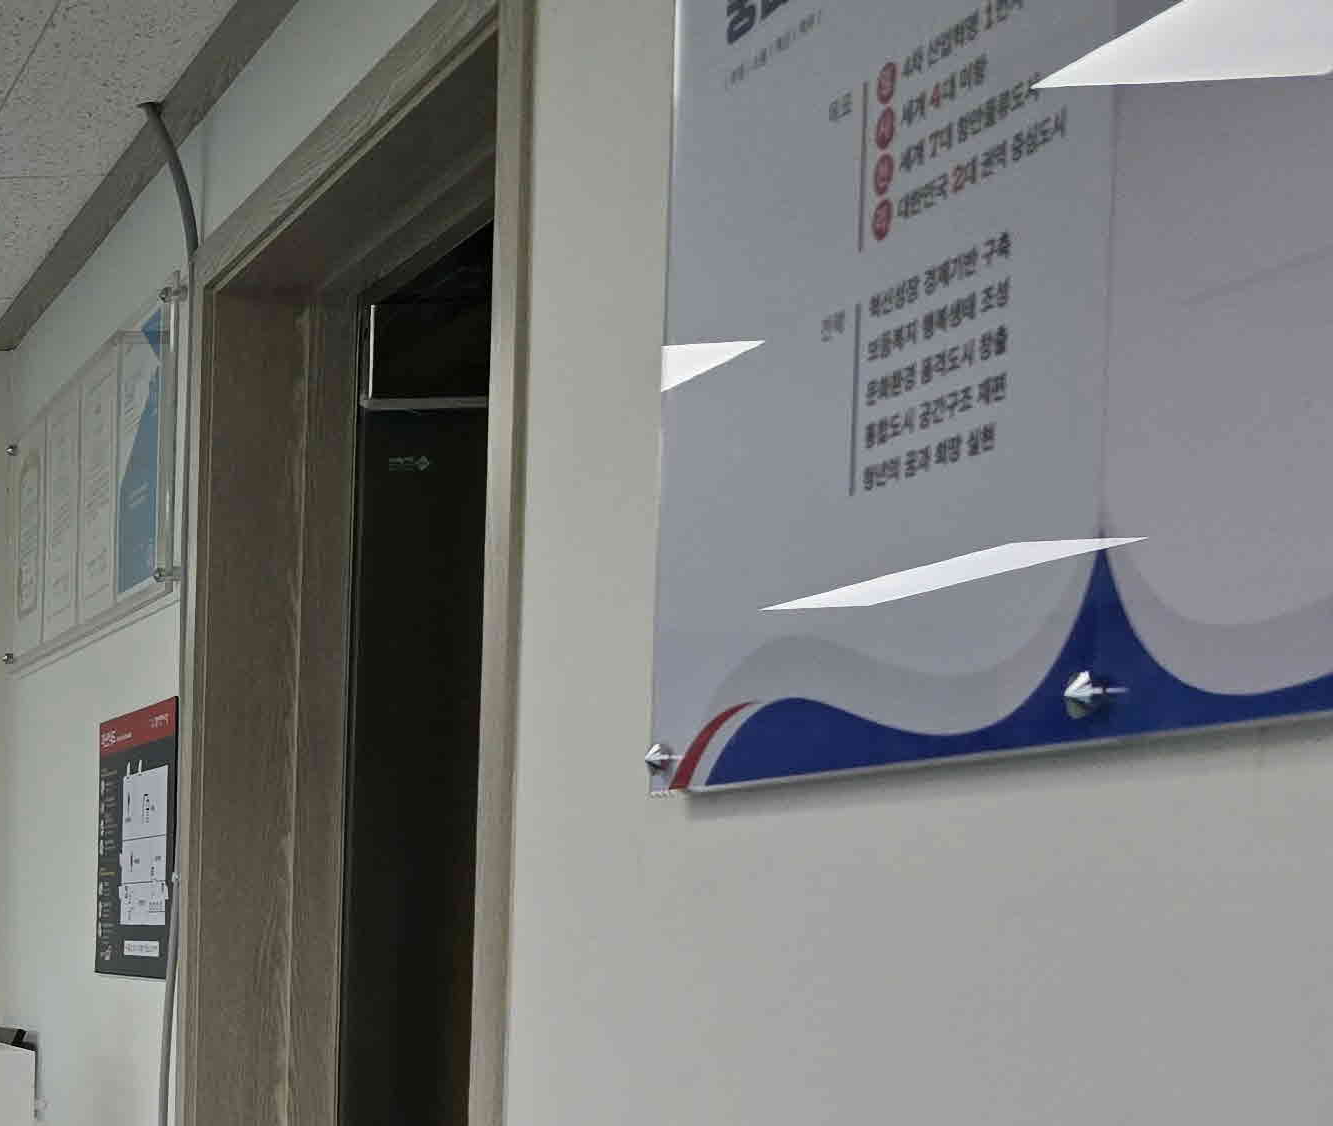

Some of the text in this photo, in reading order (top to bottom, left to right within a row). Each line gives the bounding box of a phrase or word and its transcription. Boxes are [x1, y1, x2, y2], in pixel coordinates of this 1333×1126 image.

[901, 91, 927, 126] 세계
[897, 173, 949, 220] 대한민국
[950, 154, 978, 194] 2대
[1011, 105, 1068, 163] 중심도시
[900, 137, 926, 172] 세계
[869, 231, 1011, 318] 혁신성장 경제기반 구축
[980, 276, 1011, 312] 조성
[919, 385, 973, 430] 공간구조
